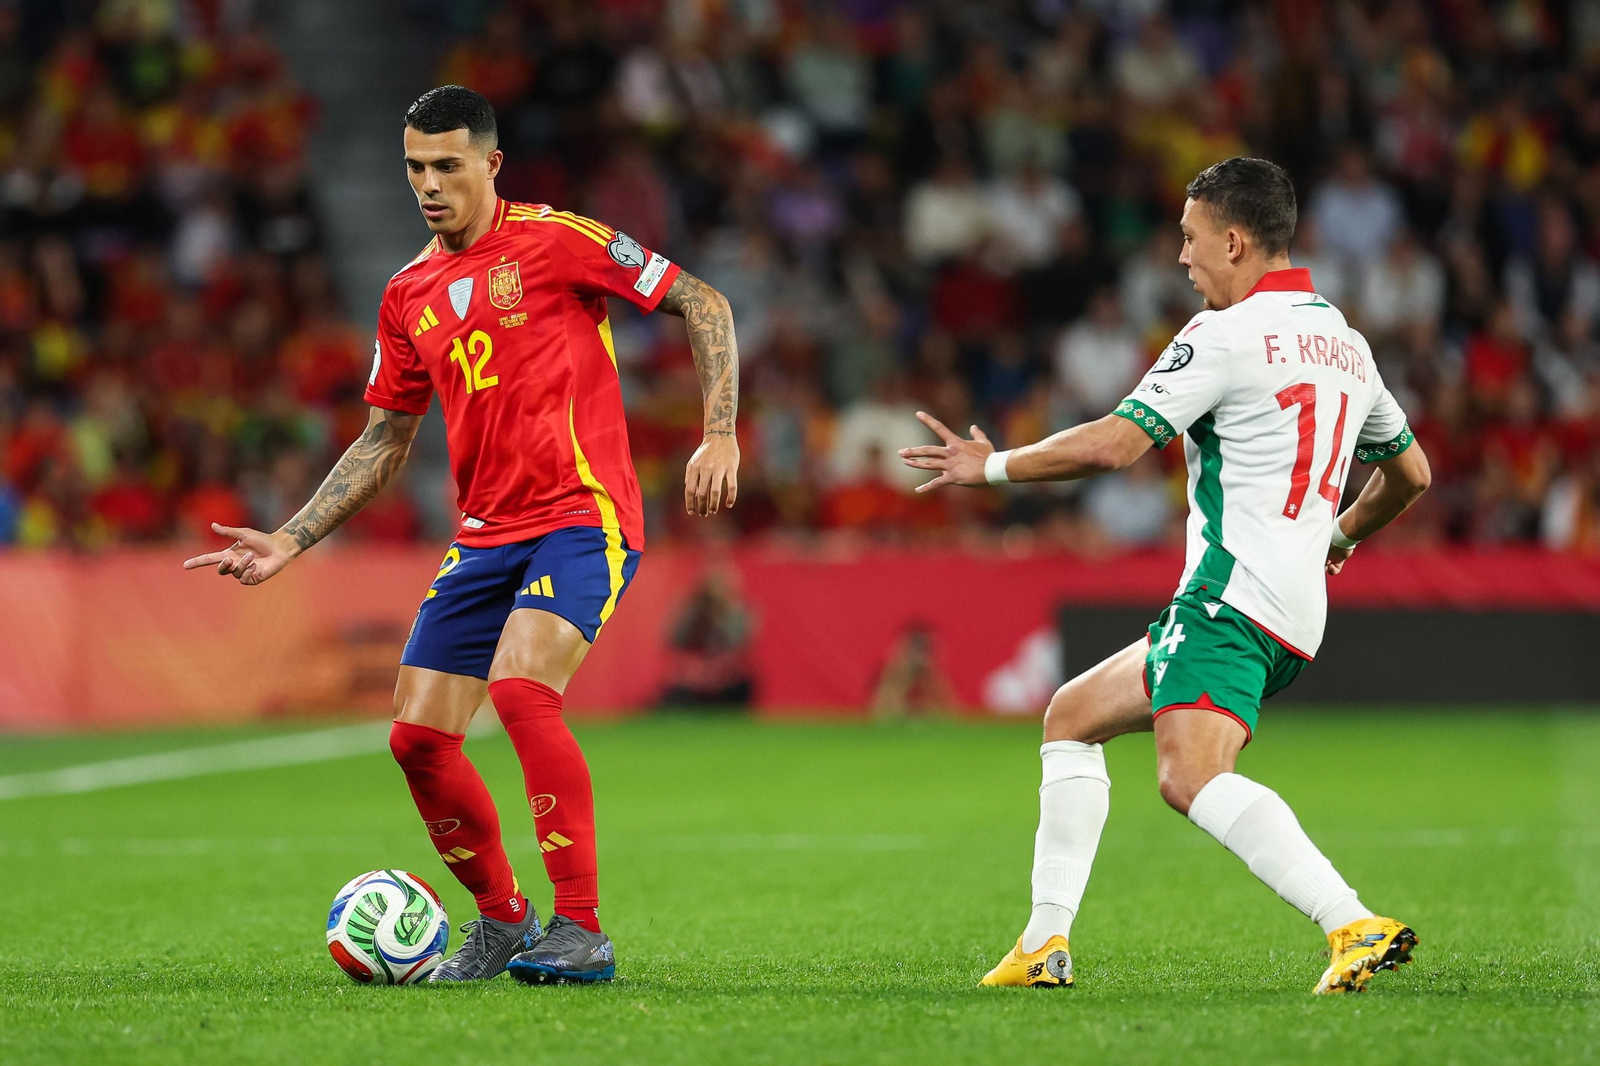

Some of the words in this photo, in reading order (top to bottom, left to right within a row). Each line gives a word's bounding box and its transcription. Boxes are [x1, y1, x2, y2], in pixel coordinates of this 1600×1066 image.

[449, 329, 499, 395] 12
[1263, 334, 1287, 364] F.
[1274, 382, 1349, 521] 14
